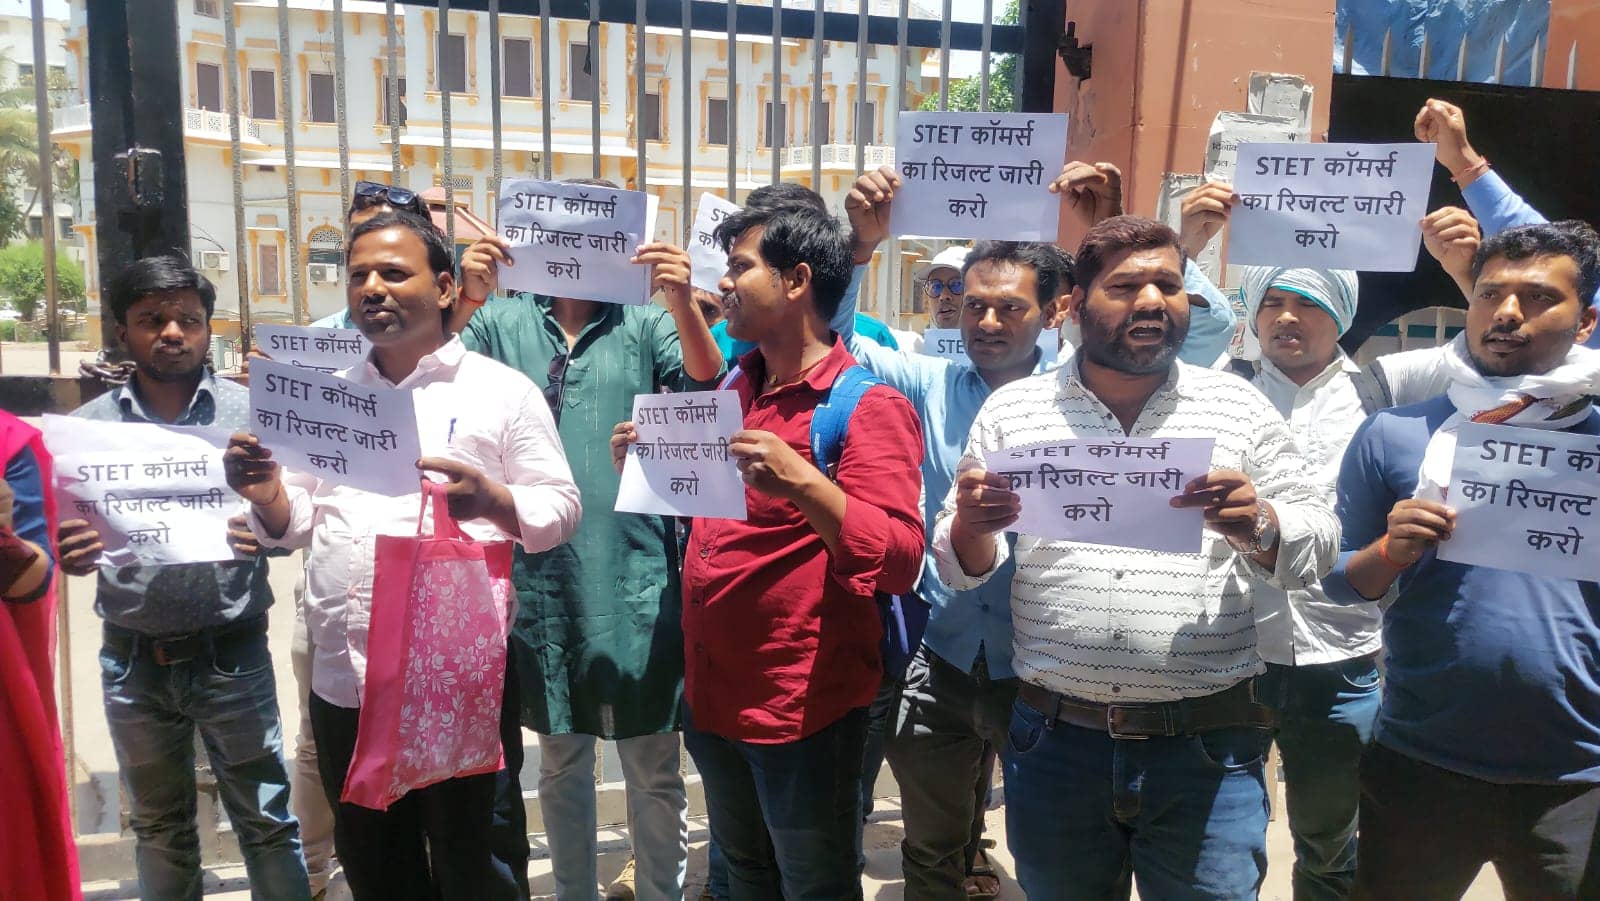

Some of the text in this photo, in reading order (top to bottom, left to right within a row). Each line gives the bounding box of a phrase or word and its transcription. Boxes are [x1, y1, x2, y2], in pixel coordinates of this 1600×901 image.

[913, 120, 1035, 146] STET कॉमर्स
[902, 156, 1044, 185] का रिजल्ट जारी
[1255, 151, 1398, 178] STET कॉमर्स
[514, 192, 617, 218] STET कॉमर्स
[949, 193, 987, 218] करो
[1241, 188, 1406, 216] का रिजल्ट जारी
[504, 222, 627, 254] का रिजल्ट जारी
[1295, 224, 1339, 249] करो
[546, 257, 582, 280] करो
[271, 333, 362, 354] STET कॉमर्स
[937, 339, 965, 354] STE
[266, 373, 377, 417] STET कॉमर्स
[638, 398, 718, 425] STET कॉमर्स
[256, 408, 397, 450] का रिजल्ट जारी
[307, 450, 348, 475] करो
[636, 437, 731, 462] का रिजल्ट जारी
[1010, 441, 1171, 460] STET कॉमर्स
[1480, 439, 1556, 467] STET
[78, 454, 208, 482] STET कॉमर्स
[998, 463, 1184, 491] का रिजल्ट जारी
[670, 471, 699, 495] करो
[73, 487, 224, 516] का रिजल्ट जारी
[1063, 496, 1113, 522] करो
[1461, 479, 1598, 516] का रिजल्ट
[128, 521, 171, 545] करो
[1527, 527, 1584, 555] करो
